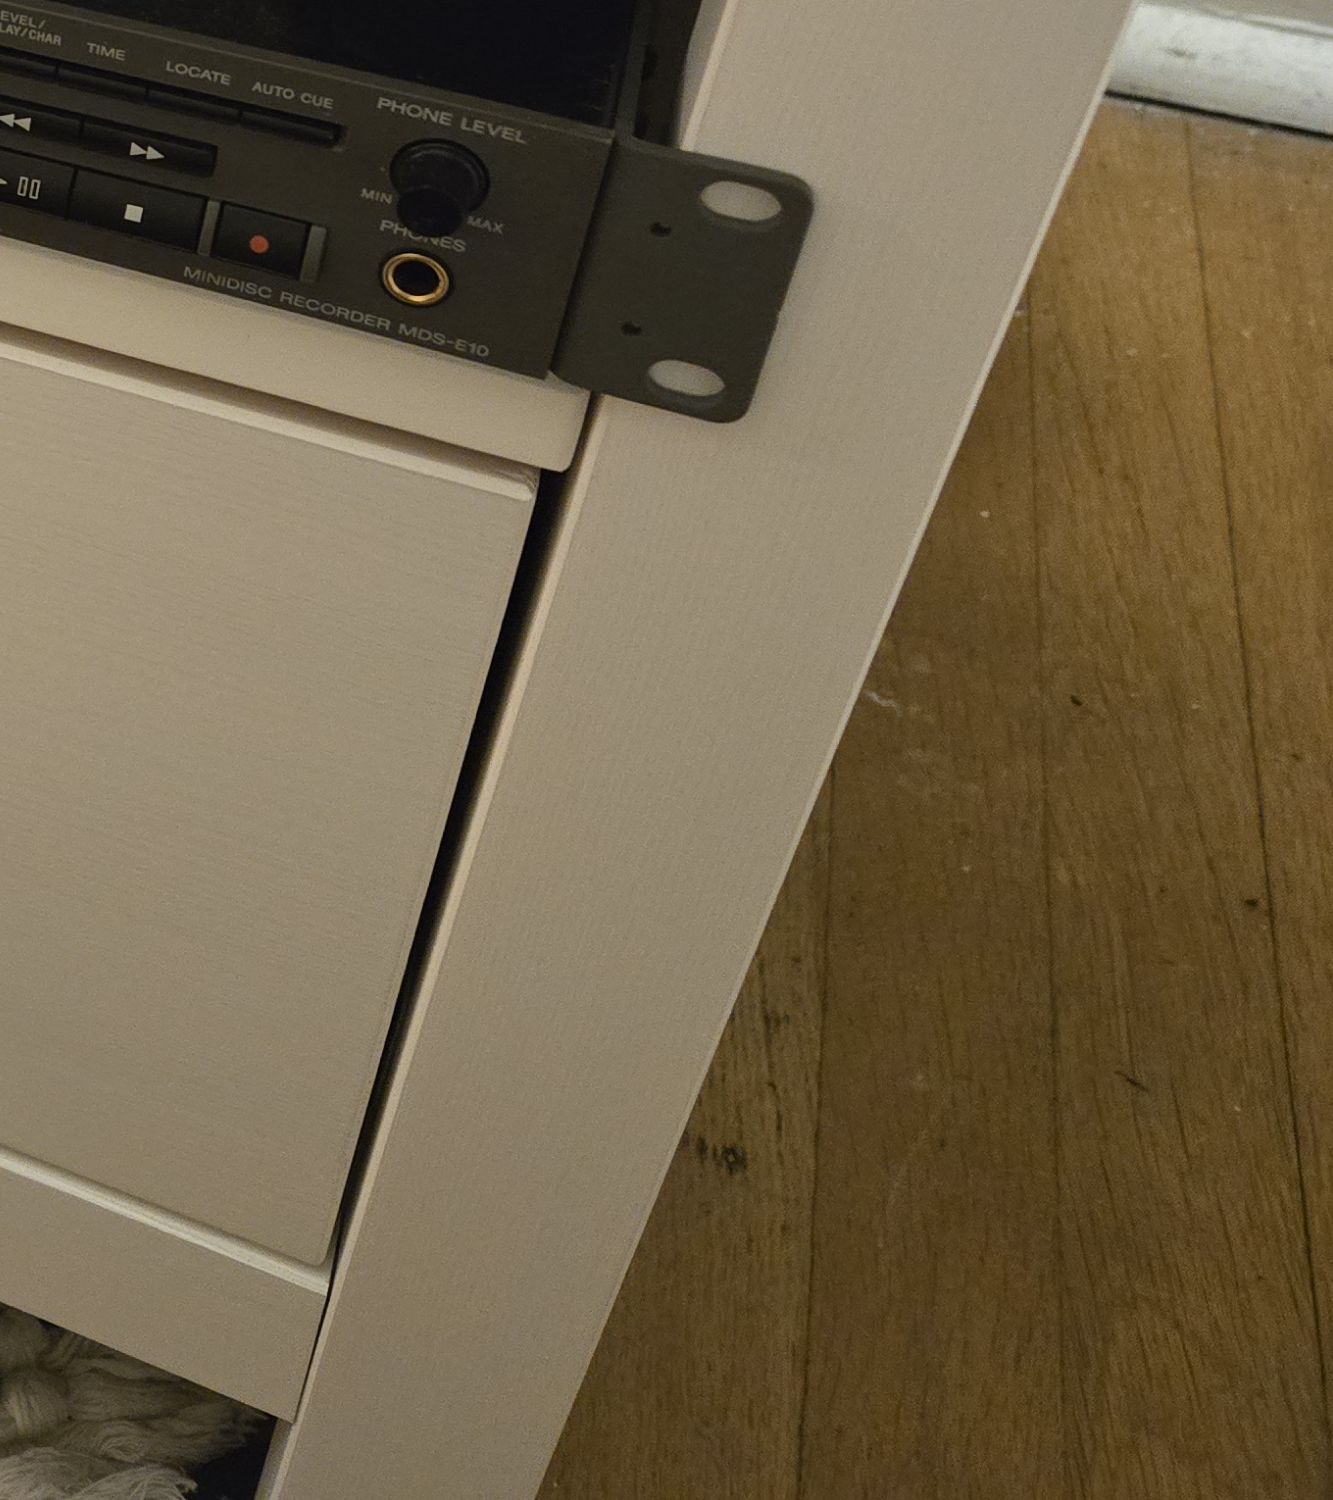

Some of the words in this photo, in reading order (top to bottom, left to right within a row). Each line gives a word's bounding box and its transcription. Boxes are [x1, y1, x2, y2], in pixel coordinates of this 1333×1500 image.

[87, 41, 127, 62] TIME
[165, 59, 232, 87] LOCATE
[251, 80, 296, 101] AUTO
[299, 91, 335, 111] CUE
[376, 96, 454, 127] PHONE
[460, 116, 529, 146] LEVEL
[360, 187, 393, 205] MIN
[466, 215, 505, 235] MAX
[183, 265, 273, 300] MINIDISC
[279, 289, 392, 332] RECORDER
[398, 322, 491, 359] MDS-E10
